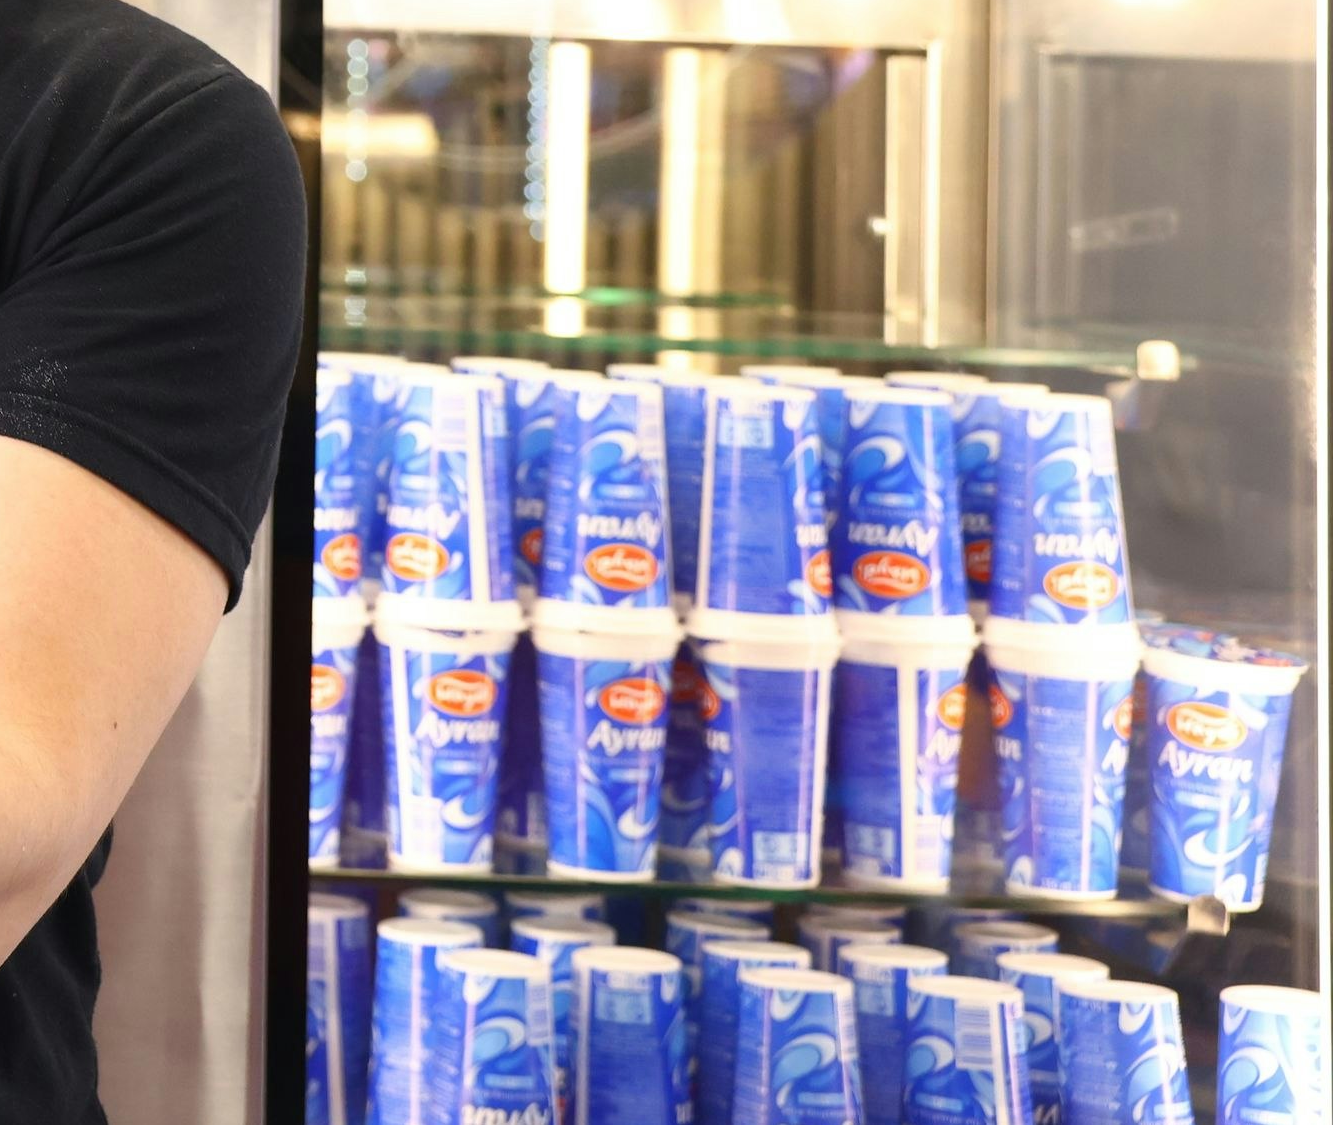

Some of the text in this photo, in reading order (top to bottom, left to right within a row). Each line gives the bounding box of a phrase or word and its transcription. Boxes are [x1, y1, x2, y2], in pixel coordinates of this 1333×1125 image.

[577, 511, 661, 547] Ayran
[848, 517, 939, 557] Ayran
[1034, 525, 1120, 564] Ayran
[586, 719, 667, 757] Ayran
[1158, 740, 1253, 783] Ayran
